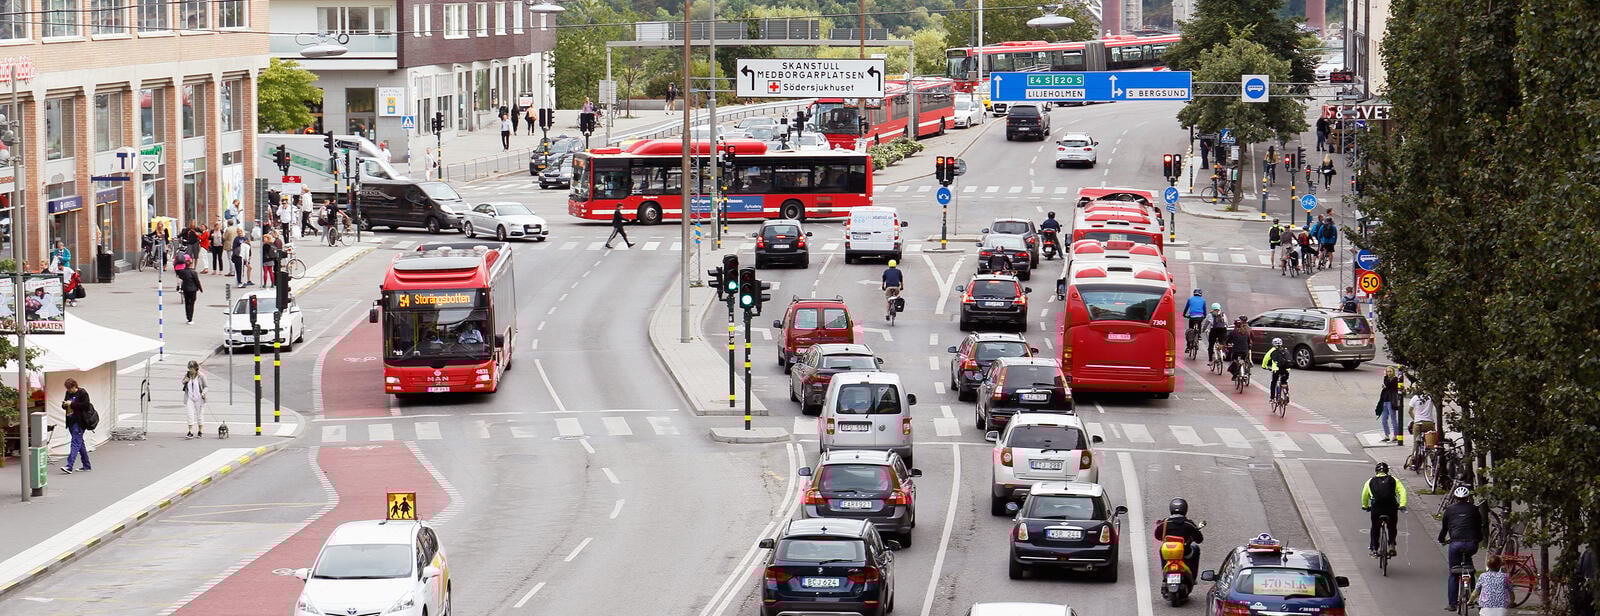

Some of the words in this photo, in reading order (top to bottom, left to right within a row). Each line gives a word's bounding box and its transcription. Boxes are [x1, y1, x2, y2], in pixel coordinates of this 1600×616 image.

[782, 62, 840, 70] SKANSTULL
[757, 71, 864, 79] MEDBORGARPLATSEN
[783, 83, 854, 93] Södersjukhuset
[1028, 90, 1083, 98] LILJEHOLMEN
[116, 152, 128, 169] T
[1363, 276, 1379, 288] 50
[399, 294, 410, 307] 54
[414, 293, 471, 305] Storängsbotten
